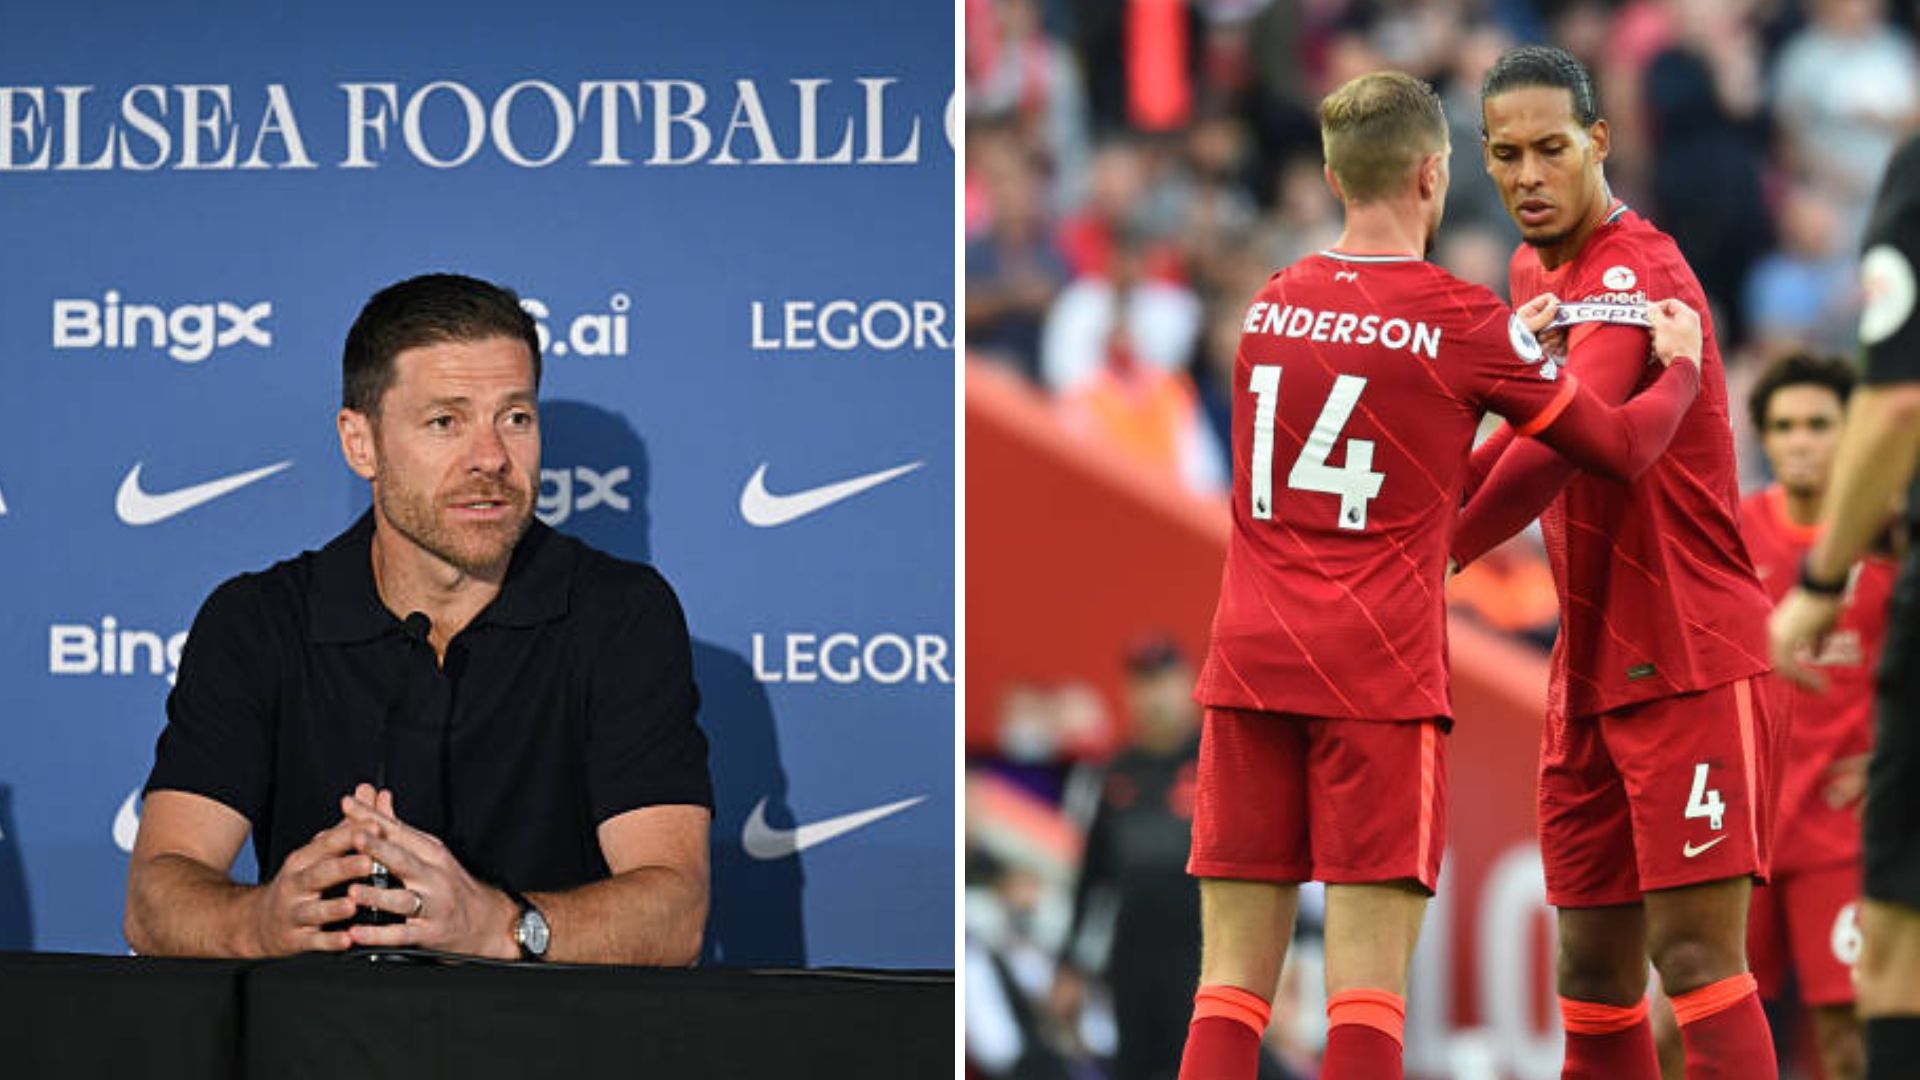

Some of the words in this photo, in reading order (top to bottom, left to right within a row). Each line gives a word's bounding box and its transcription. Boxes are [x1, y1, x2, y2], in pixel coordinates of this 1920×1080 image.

[0, 84, 319, 171] ELSEA
[338, 78, 921, 168] FOOTBALL
[53, 290, 272, 363] Bingx
[751, 300, 955, 350] LEGOR
[1249, 364, 1386, 530] 14
[752, 632, 955, 683] LEGOR
[1684, 763, 1725, 830] 4
